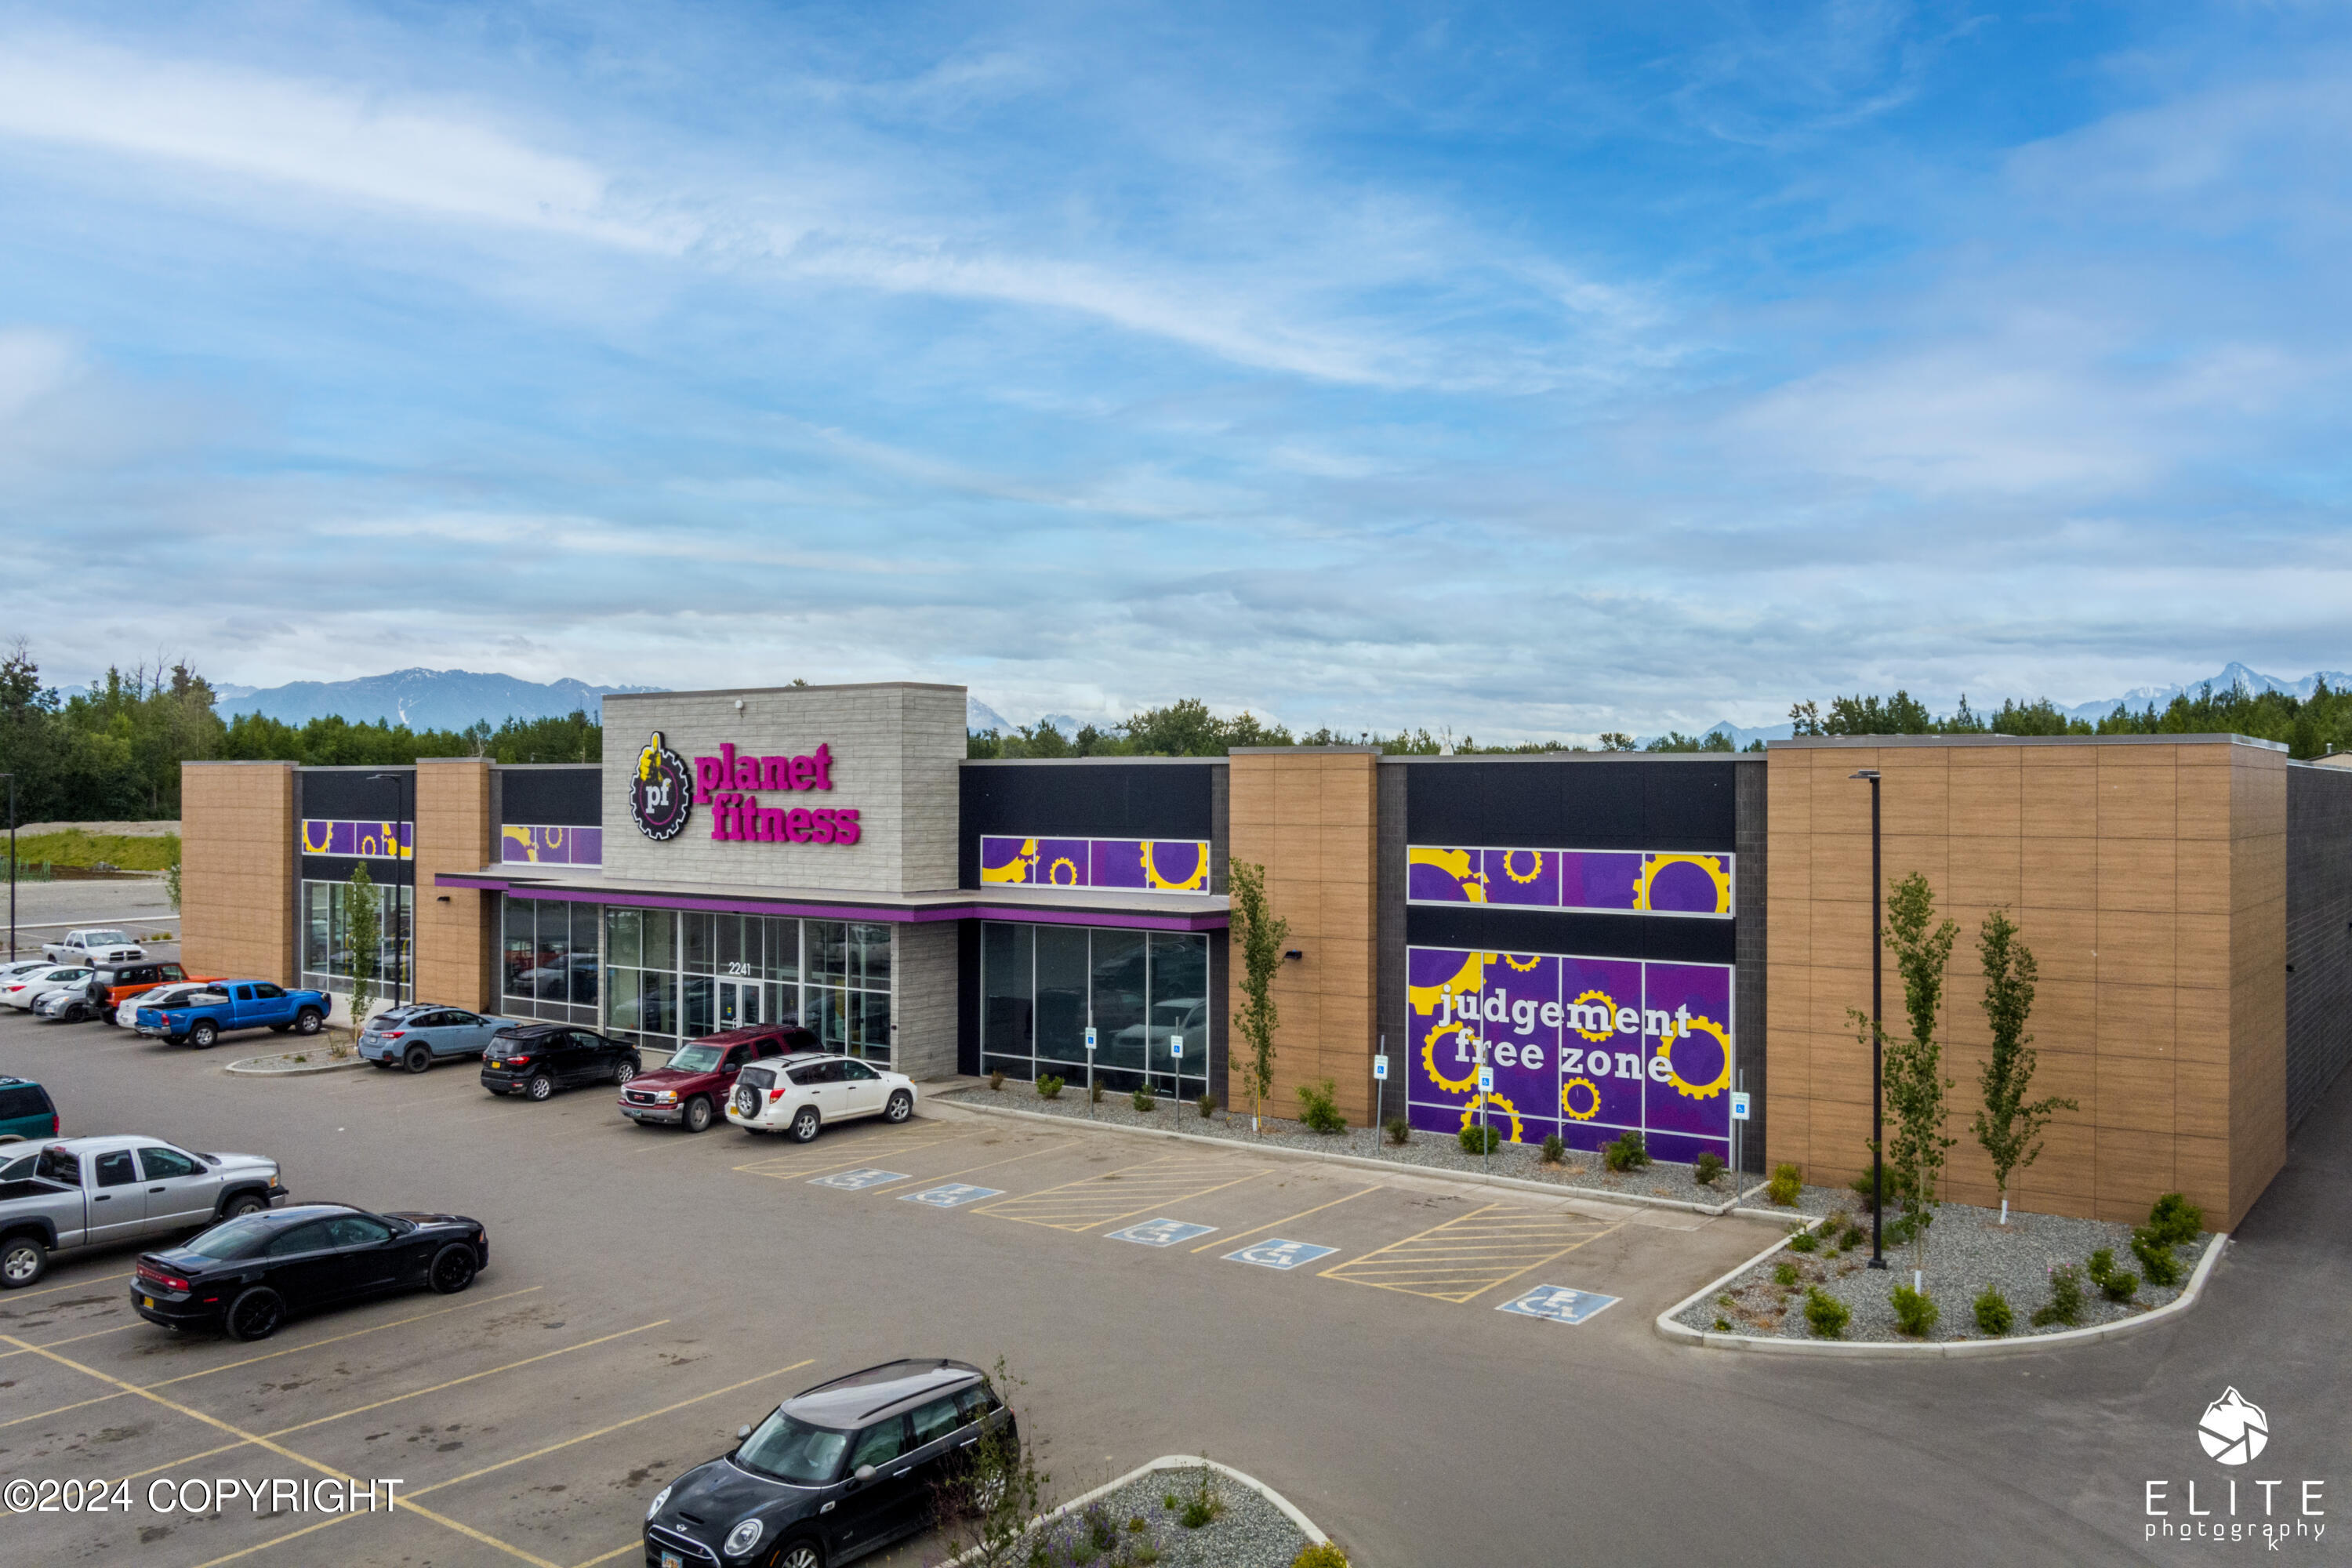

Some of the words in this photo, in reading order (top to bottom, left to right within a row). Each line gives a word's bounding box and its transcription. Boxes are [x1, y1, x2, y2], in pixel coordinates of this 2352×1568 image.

[645, 778, 671, 814] pf
[693, 742, 833, 804] planet
[711, 793, 861, 845] fitness
[728, 961, 751, 976] 2241
[1438, 983, 1692, 1039] judgement
[1454, 1028, 1545, 1071] free
[1561, 1047, 1675, 1083] zone
